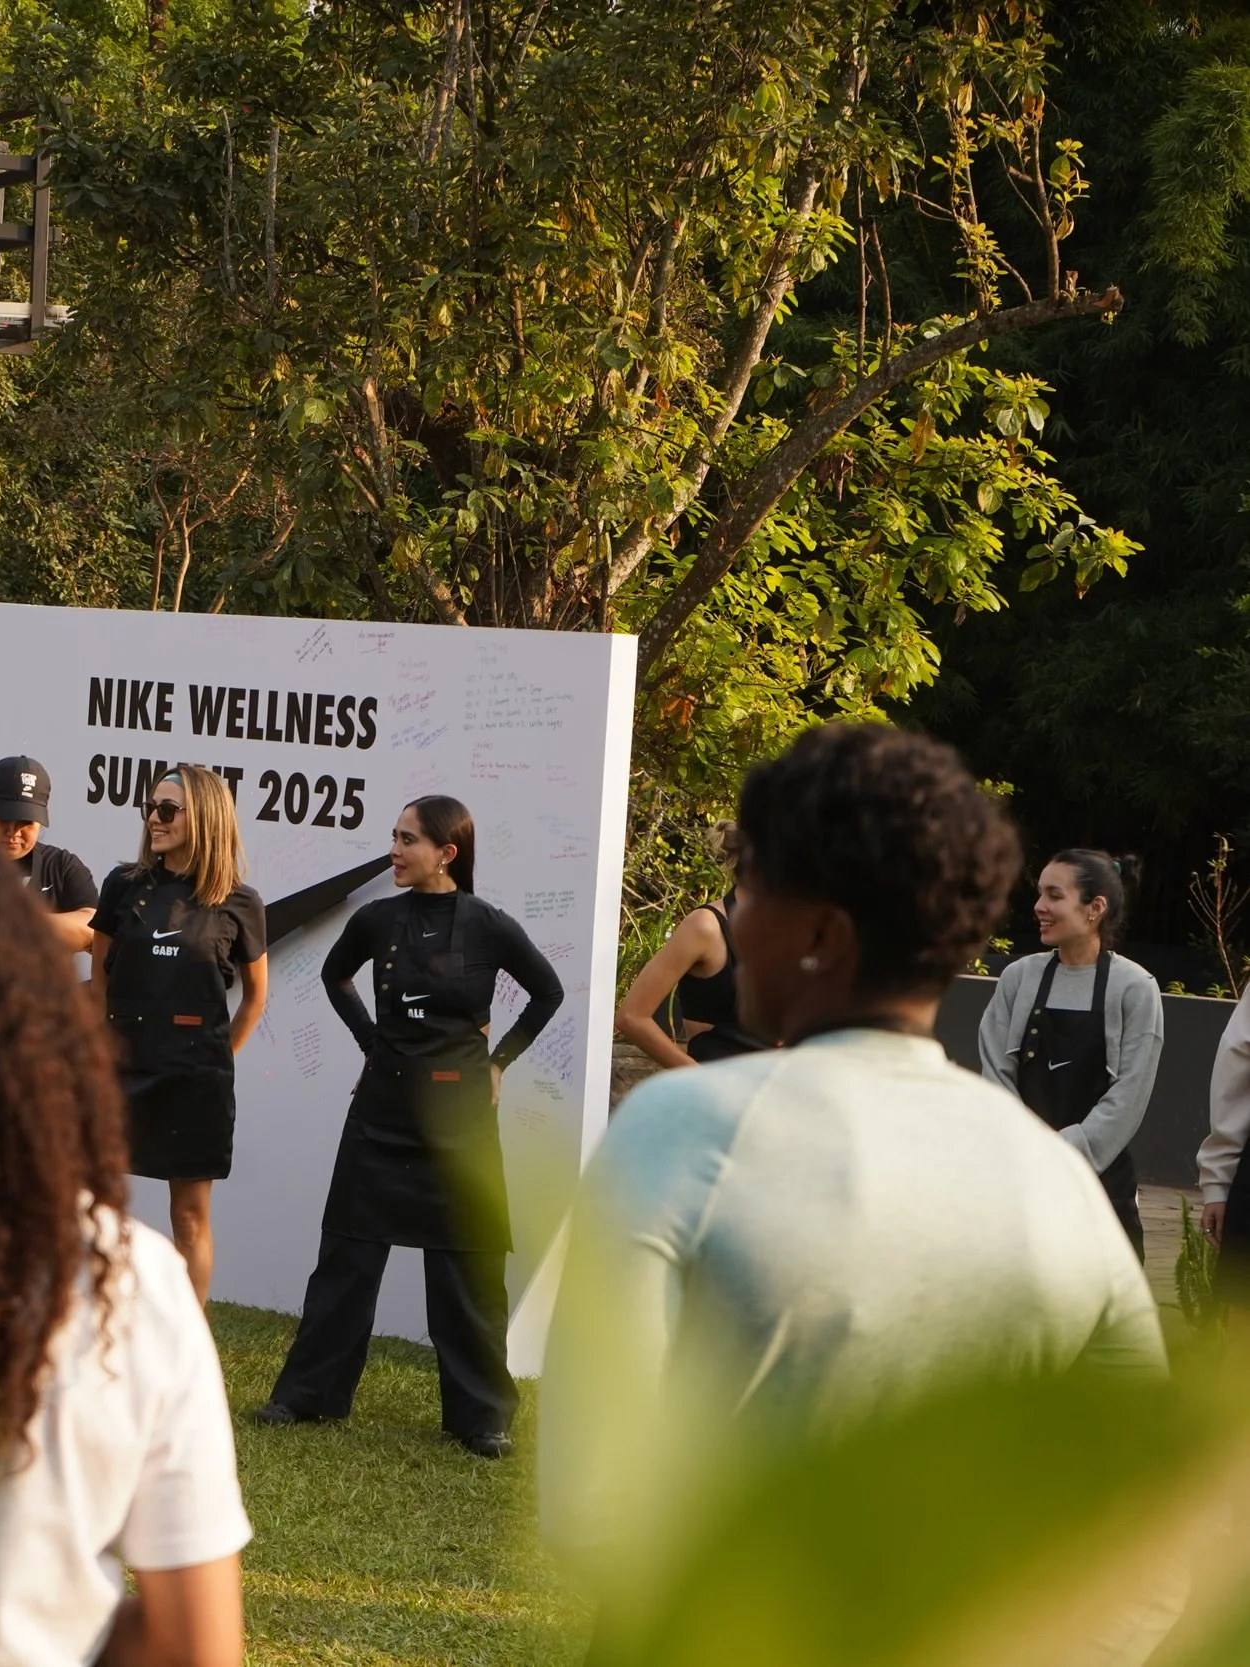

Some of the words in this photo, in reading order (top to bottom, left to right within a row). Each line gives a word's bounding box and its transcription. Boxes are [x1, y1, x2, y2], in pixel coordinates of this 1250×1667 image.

[88, 677, 175, 732] NIKE
[189, 684, 378, 750] WELLNESS
[87, 753, 244, 808] SUMT
[256, 769, 365, 830] 2025
[152, 945, 180, 957] GABY
[408, 1008, 425, 1019] ALE
